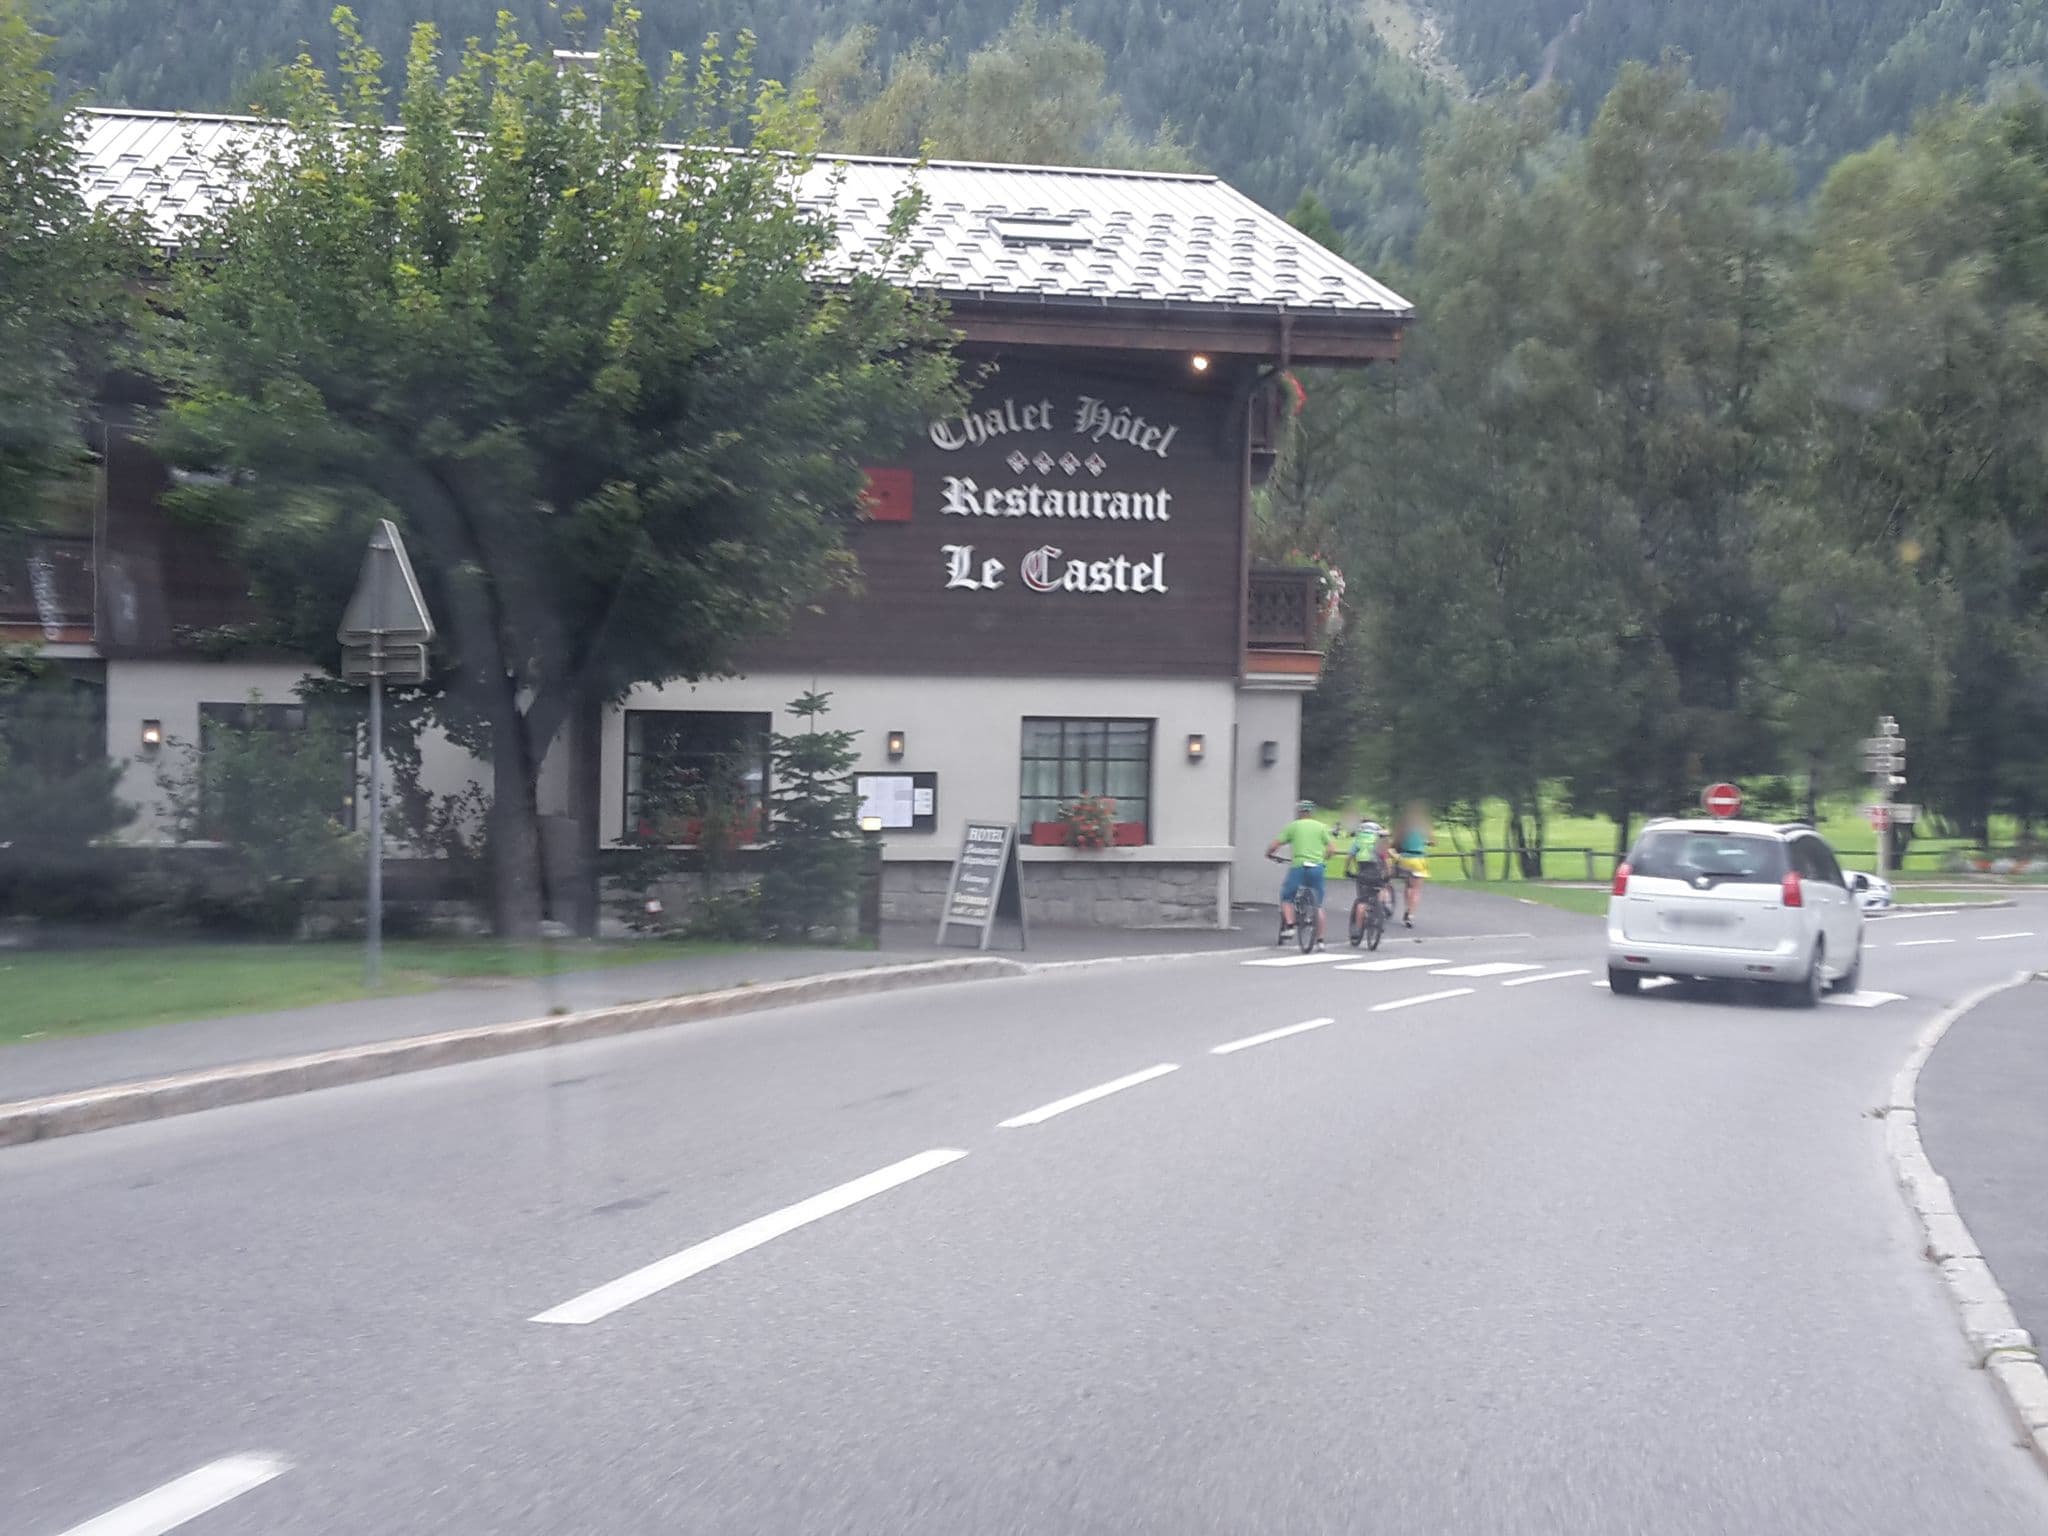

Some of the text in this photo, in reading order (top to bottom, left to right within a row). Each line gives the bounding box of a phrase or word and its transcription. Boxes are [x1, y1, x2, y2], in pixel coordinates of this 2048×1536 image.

[929, 395, 1180, 458] Chalet Hôtel
[940, 476, 1173, 521] Restaurant
[941, 544, 1169, 593] Le Castel
